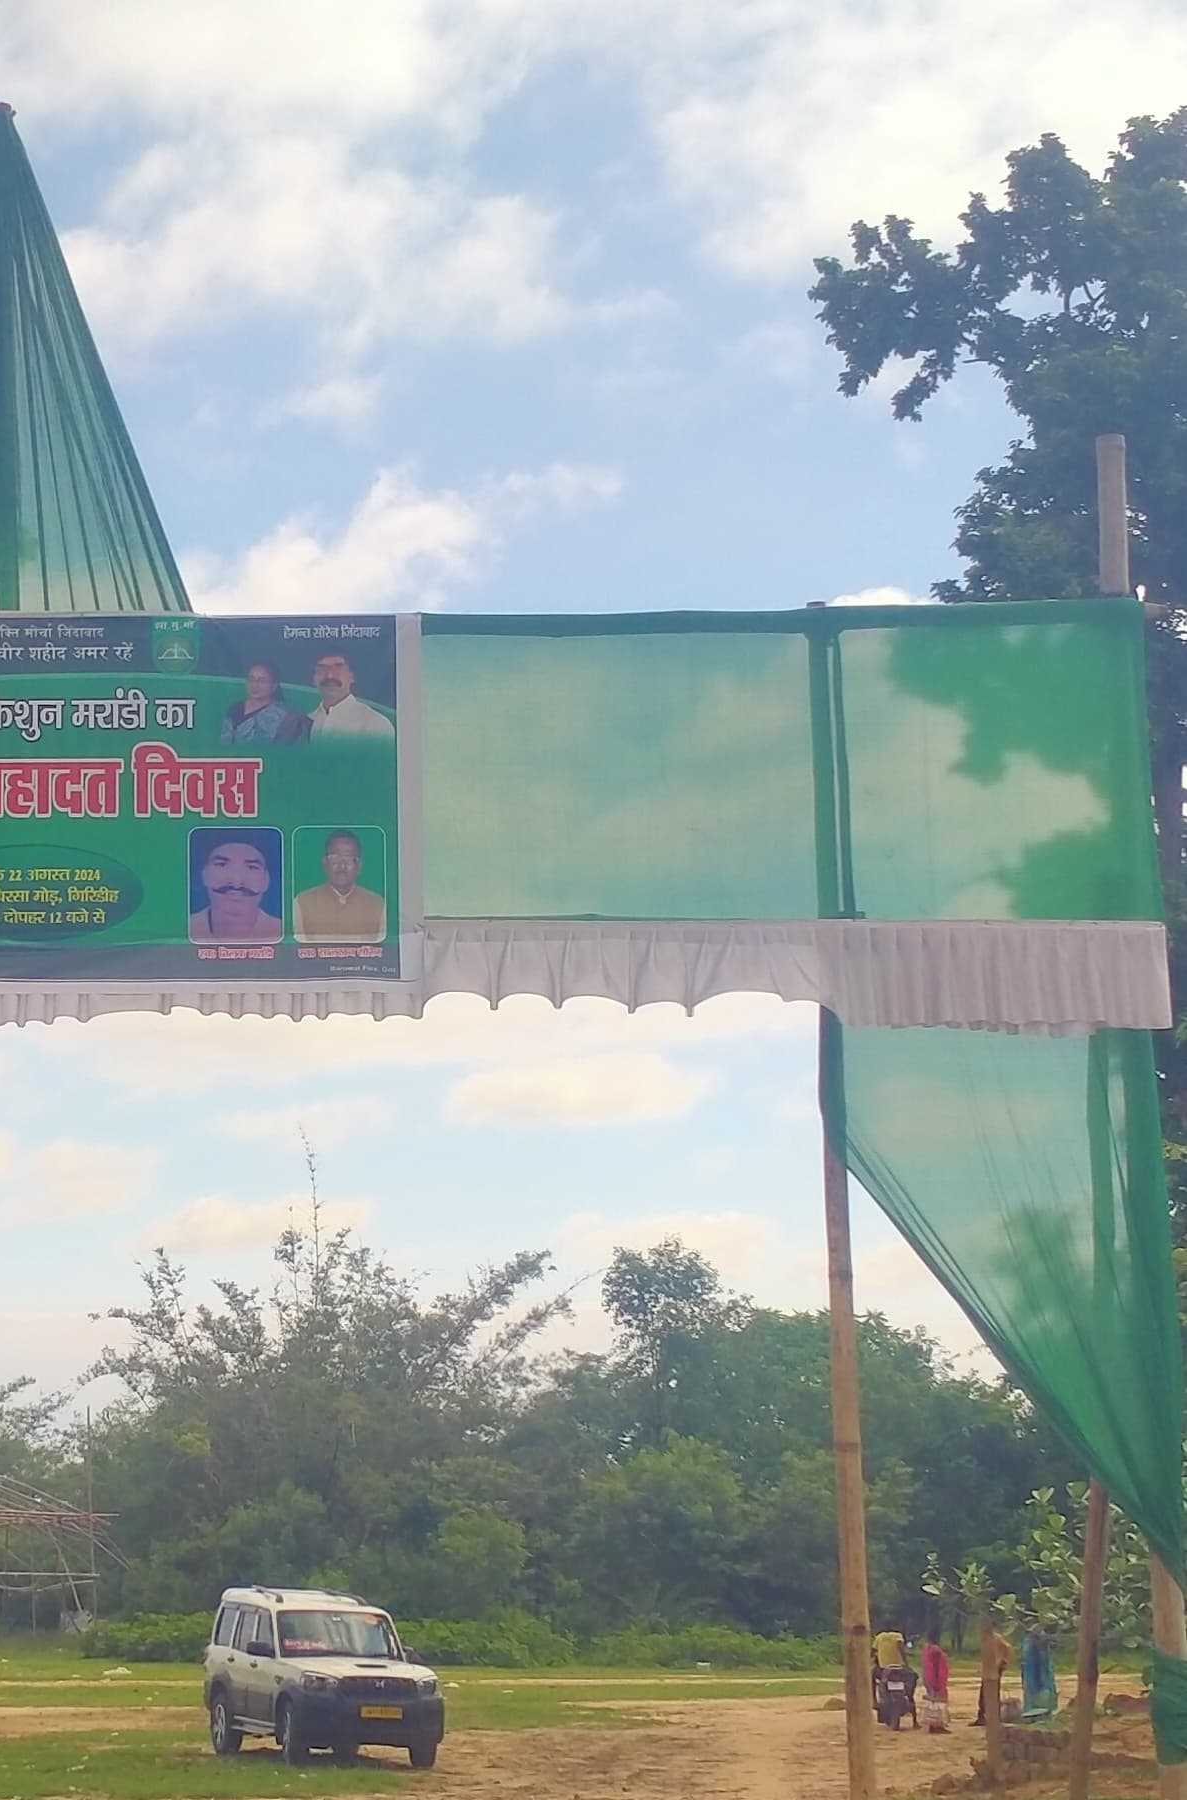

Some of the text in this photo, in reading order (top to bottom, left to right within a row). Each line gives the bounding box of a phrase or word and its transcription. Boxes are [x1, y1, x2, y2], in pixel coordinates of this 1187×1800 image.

[24, 623, 53, 639] मोर्चा
[312, 625, 339, 639] सोरेन
[29, 641, 68, 662] शहीद
[73, 646, 109, 661] अमर
[113, 642, 134, 661] रहें
[71, 687, 148, 730] मरांडी
[154, 697, 196, 730] का
[131, 741, 263, 818] दिवस
[8, 869, 22, 881] 22
[27, 868, 70, 881] अगस्त
[74, 868, 101, 881] 2024
[67, 886, 120, 903] गिरिडीह
[3, 908, 46, 924] दोपहर
[50, 911, 62, 924] 12
[93, 908, 106, 924] से
